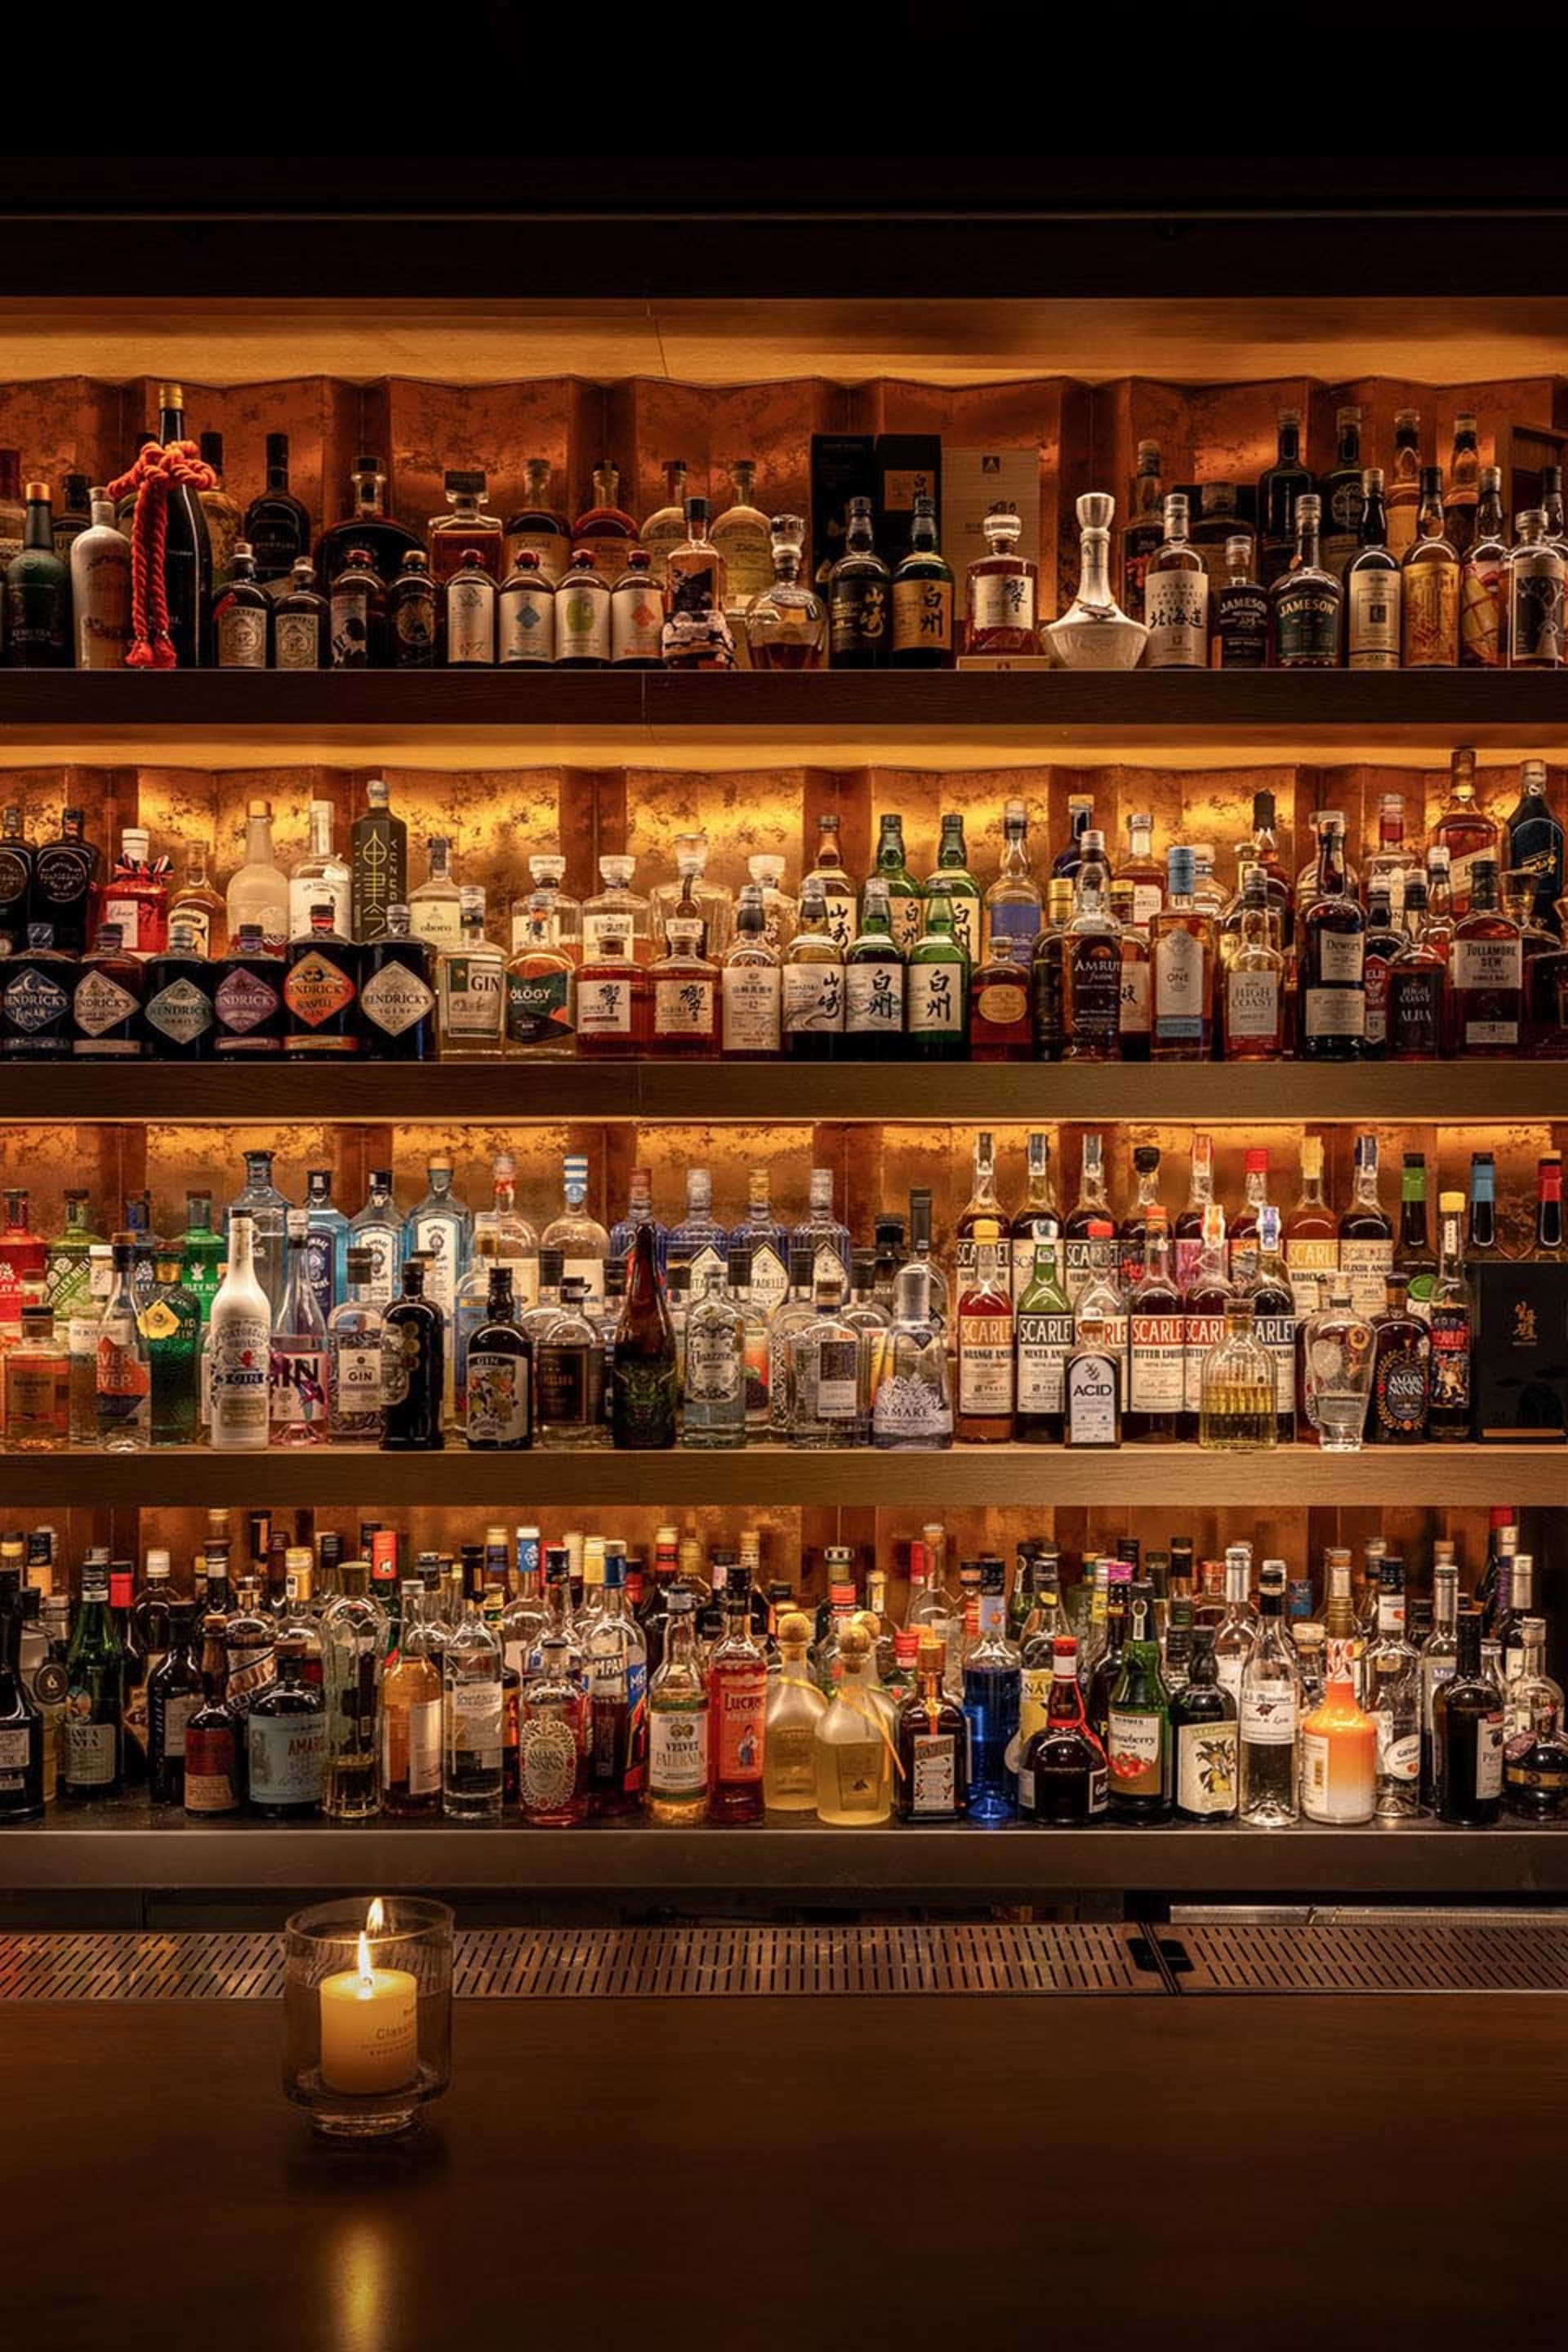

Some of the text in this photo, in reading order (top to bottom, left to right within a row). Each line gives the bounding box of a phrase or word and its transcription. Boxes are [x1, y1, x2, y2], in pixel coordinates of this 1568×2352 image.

[920, 586, 943, 638] 白州
[1279, 598, 1336, 617] JAMESON
[1150, 608, 1204, 629] 北海道
[471, 976, 500, 991] GIN
[1166, 972, 1190, 983] ONE
[869, 969, 892, 1019] 白州
[928, 969, 951, 1022] 白州
[349, 1371, 373, 1382] GIN
[1073, 1384, 1112, 1396] ACID
